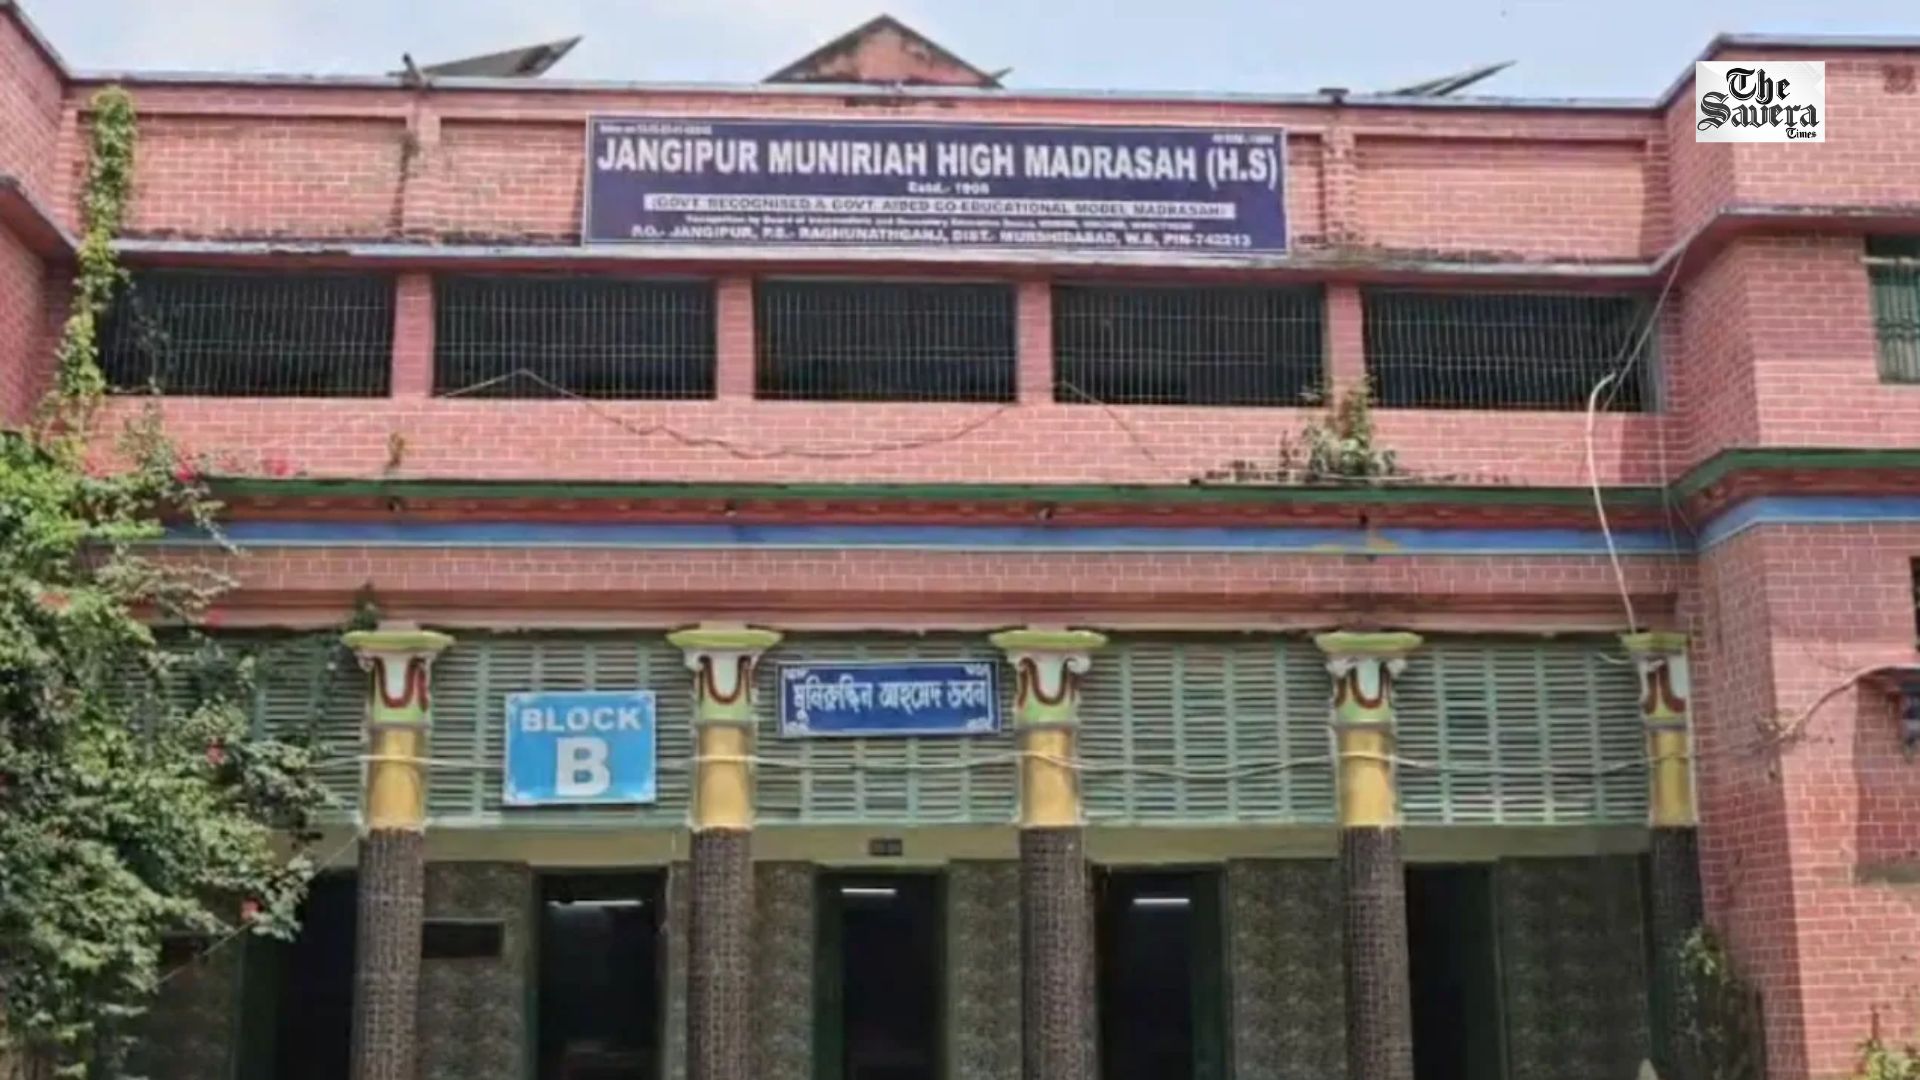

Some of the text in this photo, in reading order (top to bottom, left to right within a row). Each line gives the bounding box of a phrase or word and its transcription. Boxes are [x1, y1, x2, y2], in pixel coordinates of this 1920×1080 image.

[597, 137, 1277, 190] JANGIPUR MUNIRIAH HIGH MADRASAH (H.S)
[1075, 203, 1127, 215] MODEL
[521, 706, 642, 732] BLOCK
[556, 737, 611, 796] B
